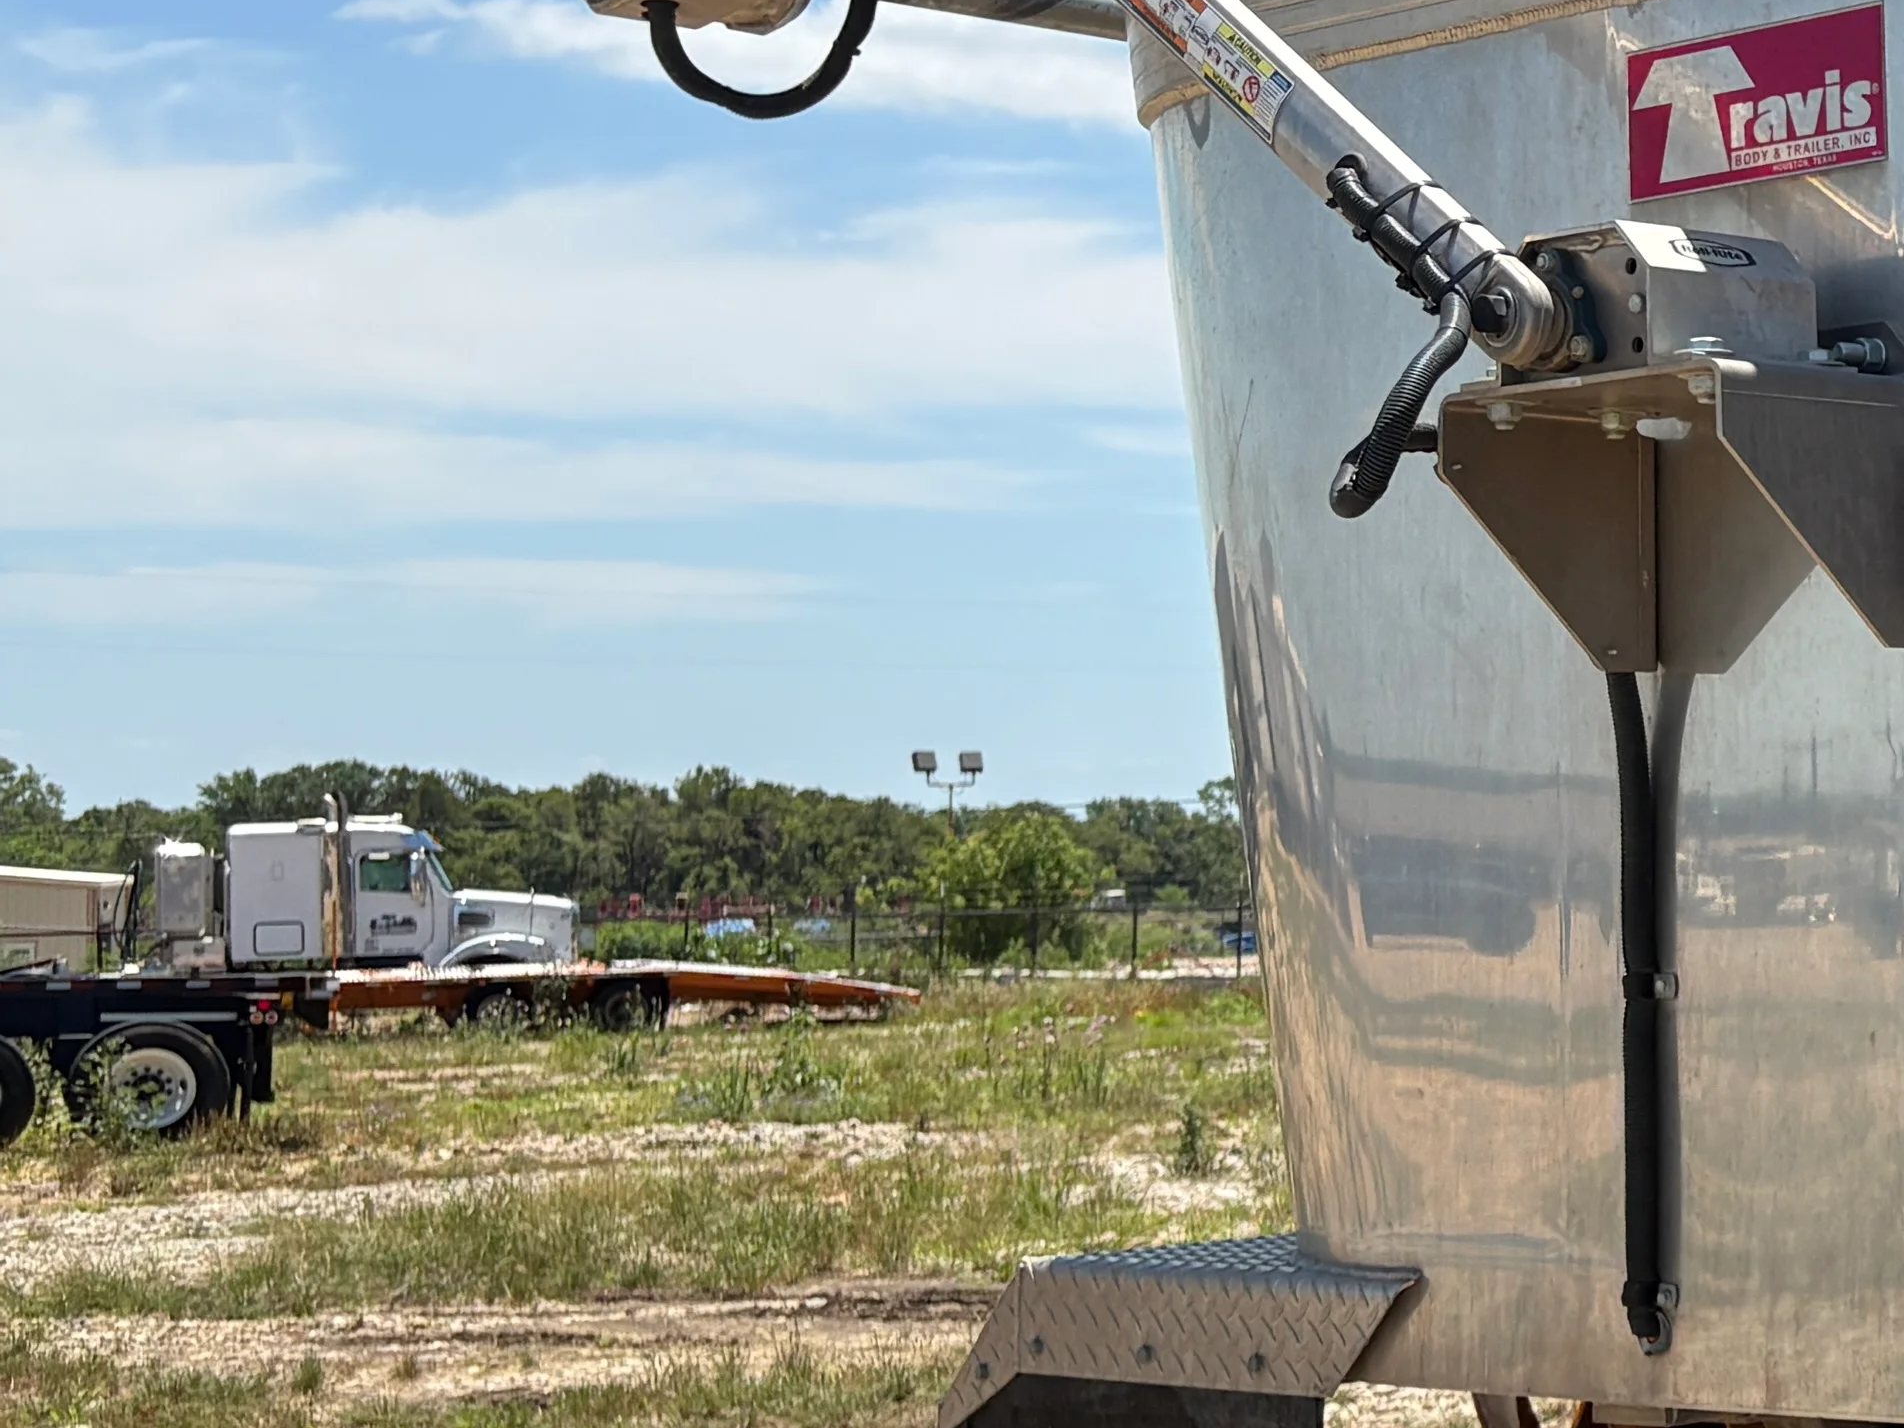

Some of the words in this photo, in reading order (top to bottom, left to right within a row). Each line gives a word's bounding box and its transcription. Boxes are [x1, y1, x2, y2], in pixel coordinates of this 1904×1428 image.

[1632, 45, 1872, 184] Travis
[1734, 149, 1768, 167] BODY
[1773, 146, 1781, 160] &
